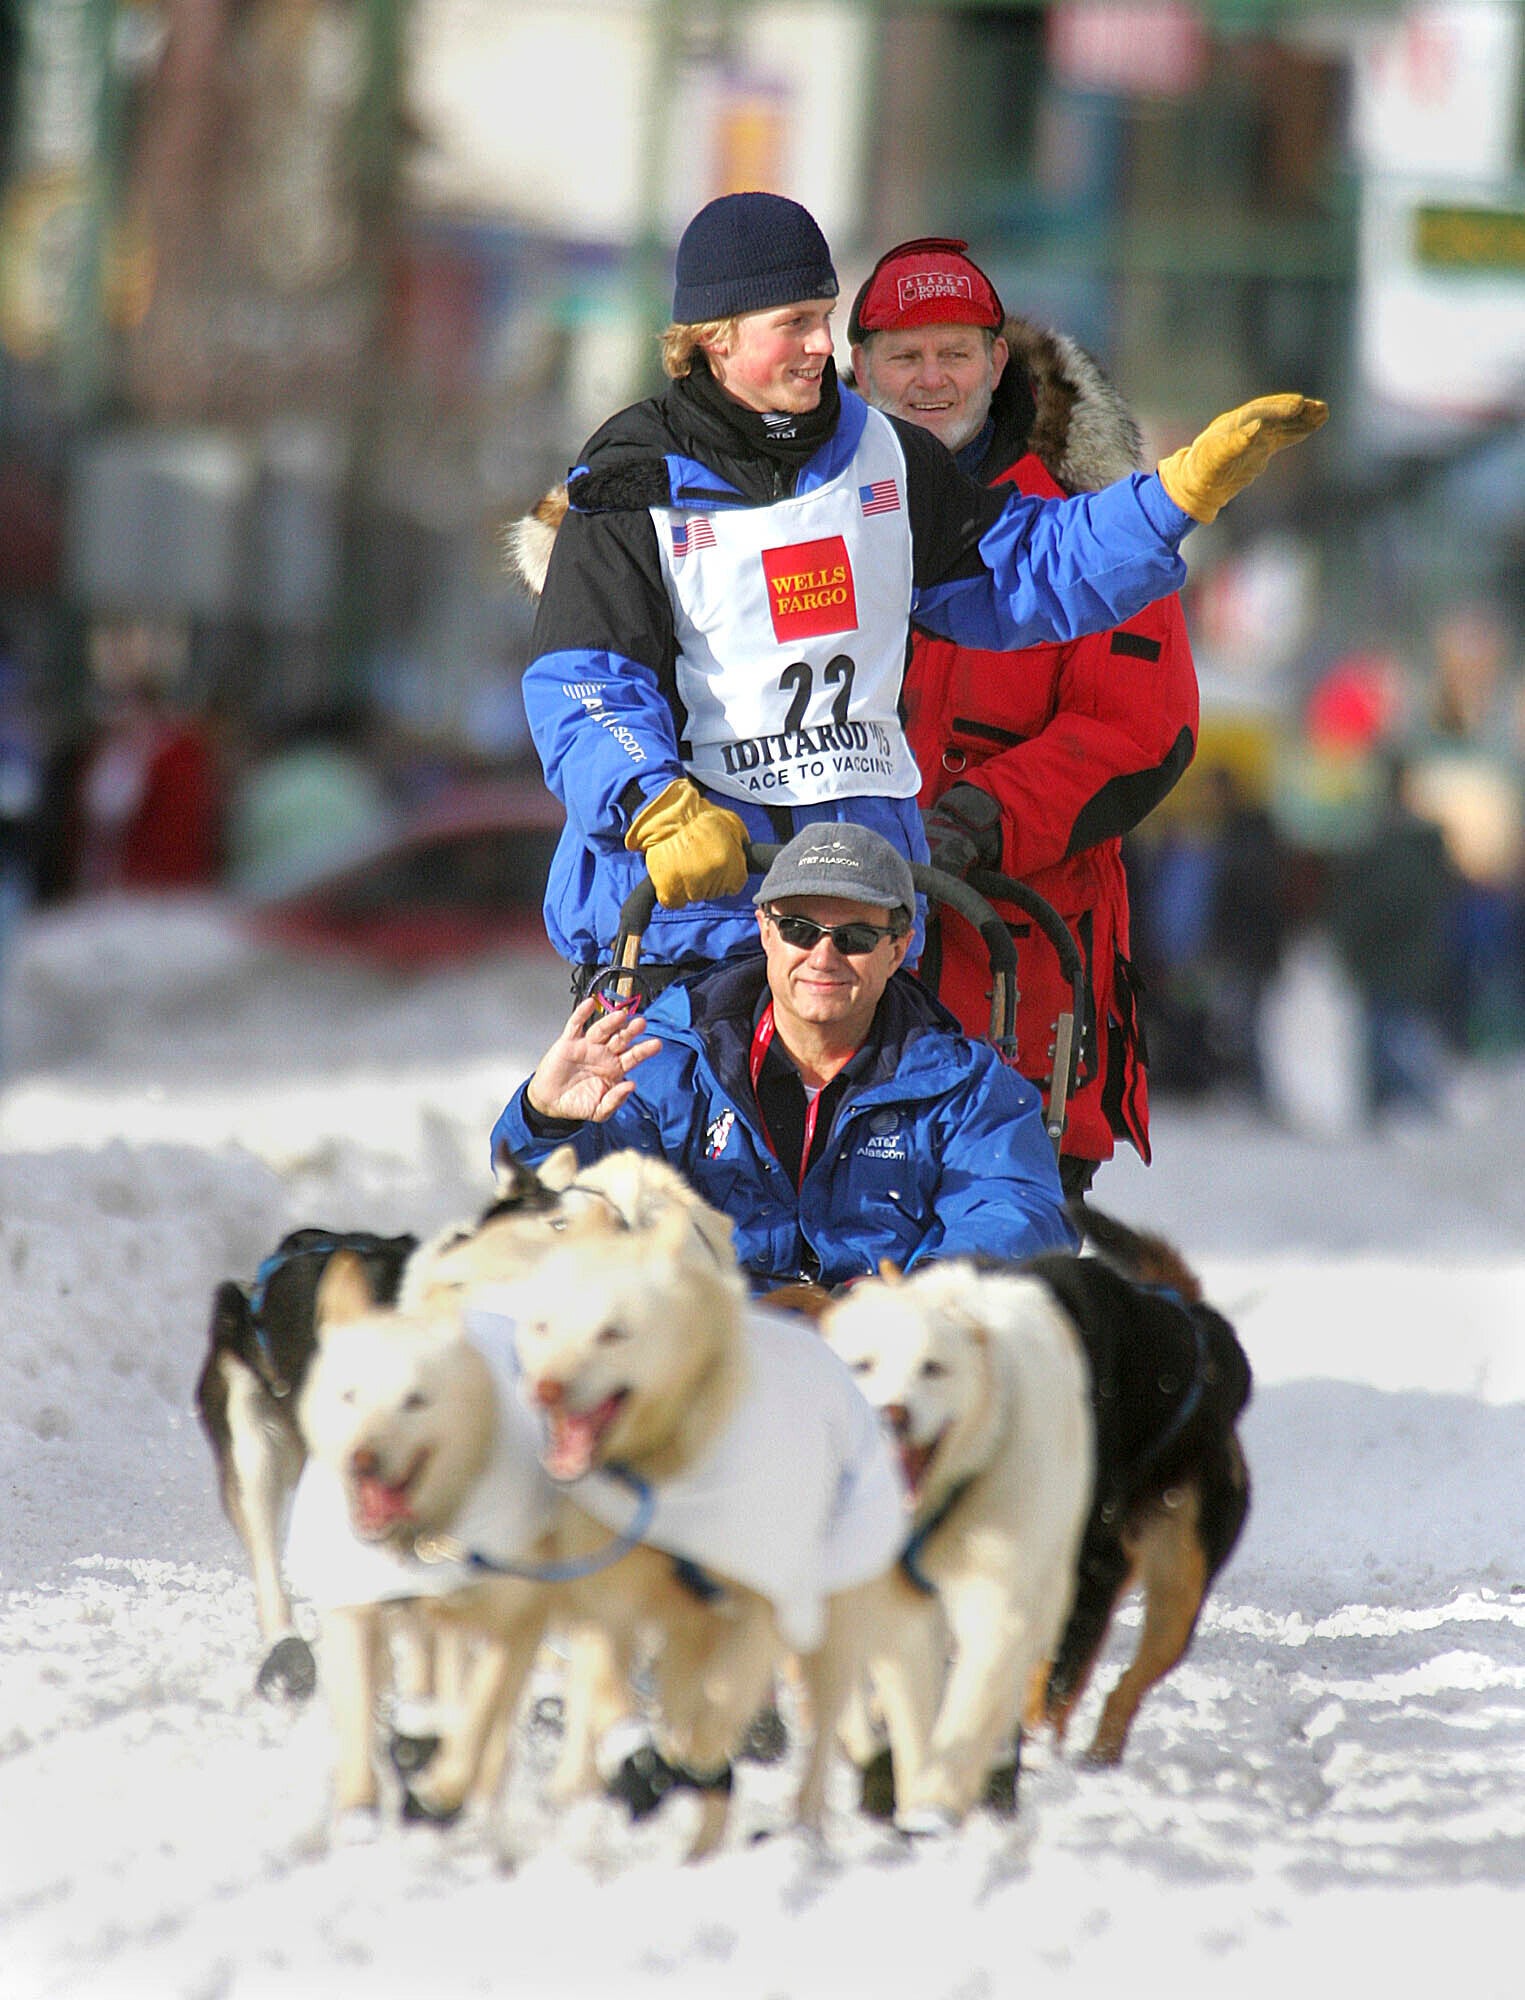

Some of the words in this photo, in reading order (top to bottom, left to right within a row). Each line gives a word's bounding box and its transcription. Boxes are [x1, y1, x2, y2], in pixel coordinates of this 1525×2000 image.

[906, 276, 964, 289] ALASKA
[919, 284, 957, 294] DODGE
[771, 566, 846, 595] WELLS
[776, 587, 848, 616] FARGO
[778, 654, 856, 736] 22
[721, 721, 868, 776] IDITAROD
[740, 768, 790, 791] ACE
[797, 761, 824, 779] TO
[819, 856, 859, 867] ALASCOM
[867, 1135, 900, 1148] AT&T
[857, 1147, 905, 1160] Alascom
